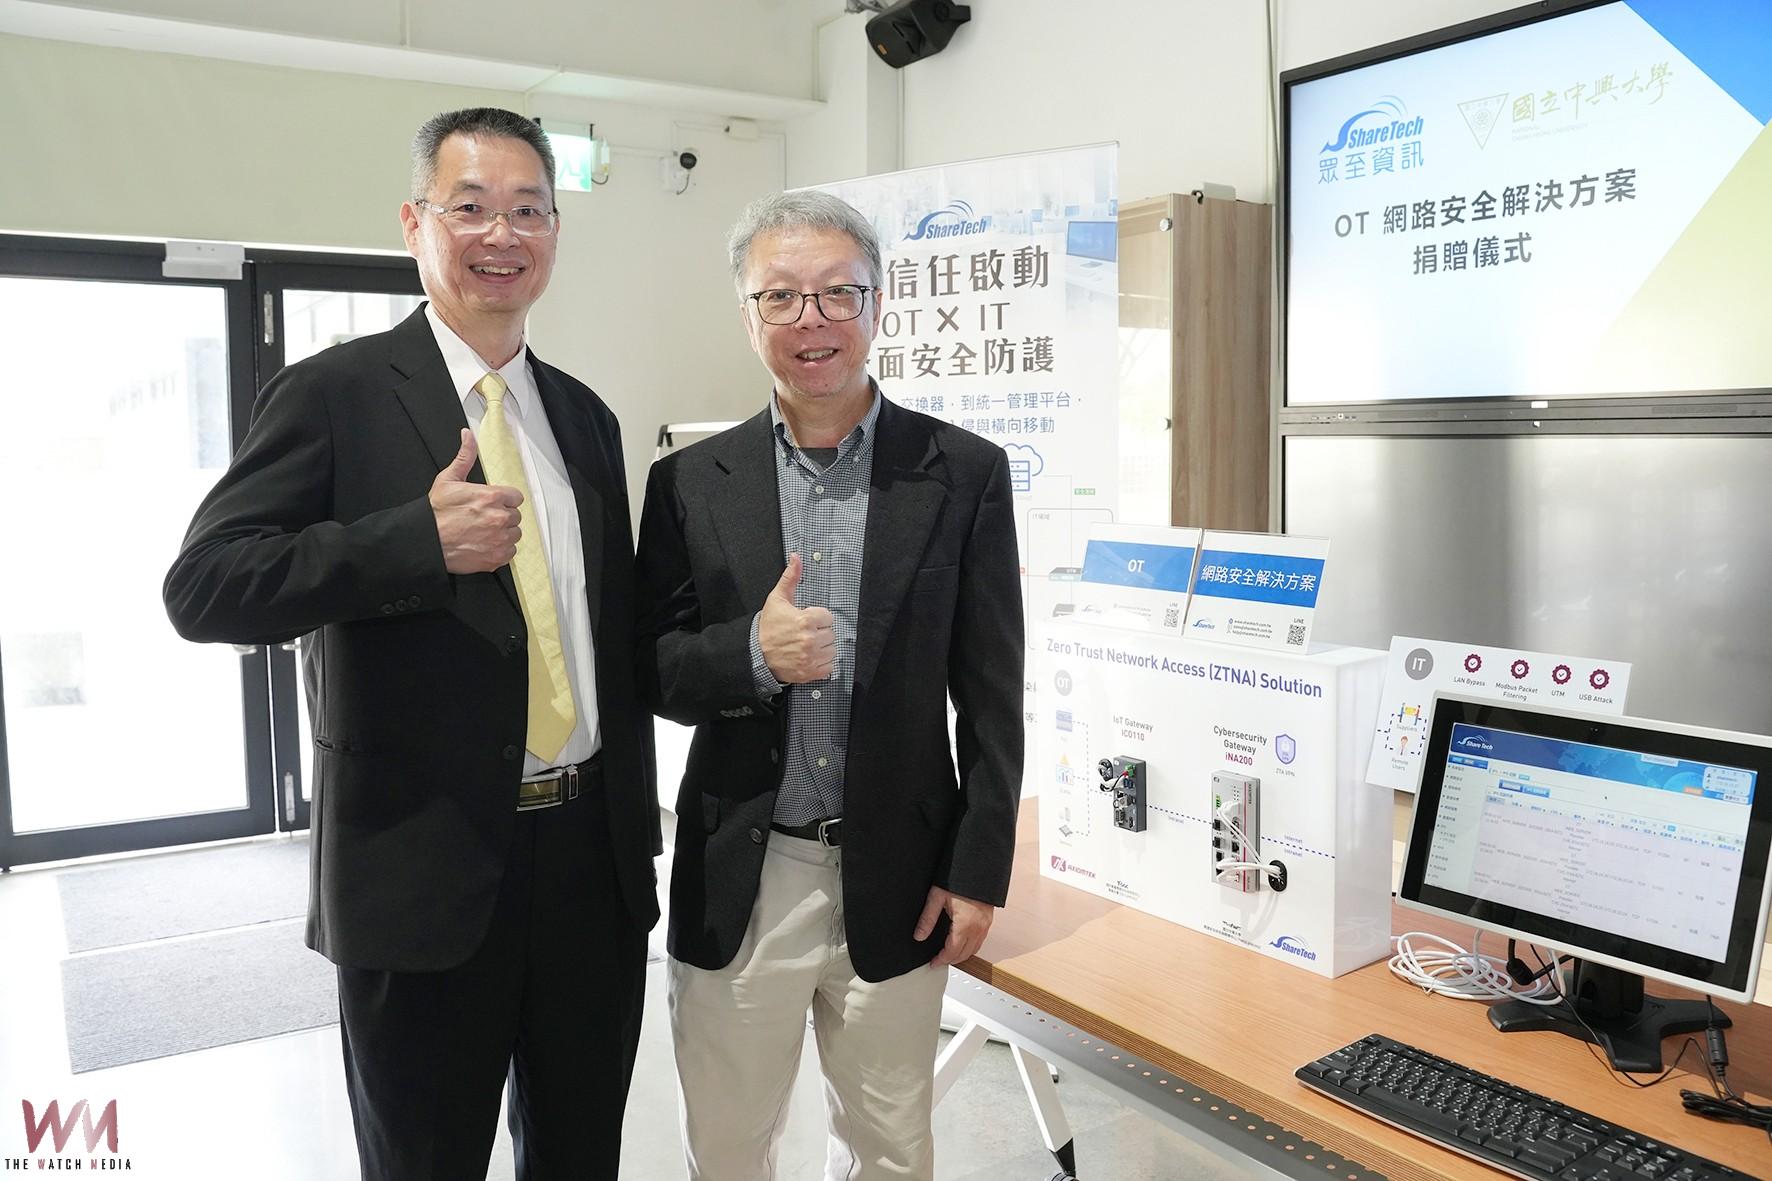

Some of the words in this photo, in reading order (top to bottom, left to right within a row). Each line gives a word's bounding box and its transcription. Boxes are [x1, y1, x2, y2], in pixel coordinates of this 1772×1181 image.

[1512, 61, 1674, 123] 國立中興大學
[1348, 115, 1424, 150] ShareTech
[1318, 142, 1425, 184] 眾至資訊
[1335, 212, 1369, 238] OT
[1383, 168, 1637, 236] 網路安全解決方案
[927, 218, 987, 240] ShareTech
[1413, 232, 1532, 275] 捐贈儀式
[882, 309, 923, 337] OT
[980, 302, 1011, 331] IT
[1127, 559, 1145, 573] OT
[1201, 564, 1318, 592] 網路安全解決方案
[1047, 638, 1072, 655] Zero
[1075, 643, 1104, 661] Trust
[1107, 650, 1158, 670] Network
[1161, 657, 1205, 677] Access
[1209, 664, 1256, 688] (ZTNA)
[1260, 673, 1322, 698] Solution
[1412, 657, 1426, 671] IT
[1056, 677, 1071, 690] OT
[1453, 676, 1465, 684] LAN
[1466, 678, 1486, 687] Bypass
[1495, 682, 1517, 692] Modbus
[1518, 685, 1538, 694] Packet
[1503, 691, 1527, 701] Filtering
[1578, 693, 1592, 701] USB
[1593, 696, 1614, 704] Attack
[1113, 715, 1123, 725] IoT
[1125, 717, 1154, 732] Gateway
[1213, 725, 1268, 746] Cybersecurity
[1223, 739, 1257, 756] Gateway
[1225, 752, 1253, 766] iNA200
[1281, 941, 1317, 962] ShareTech
